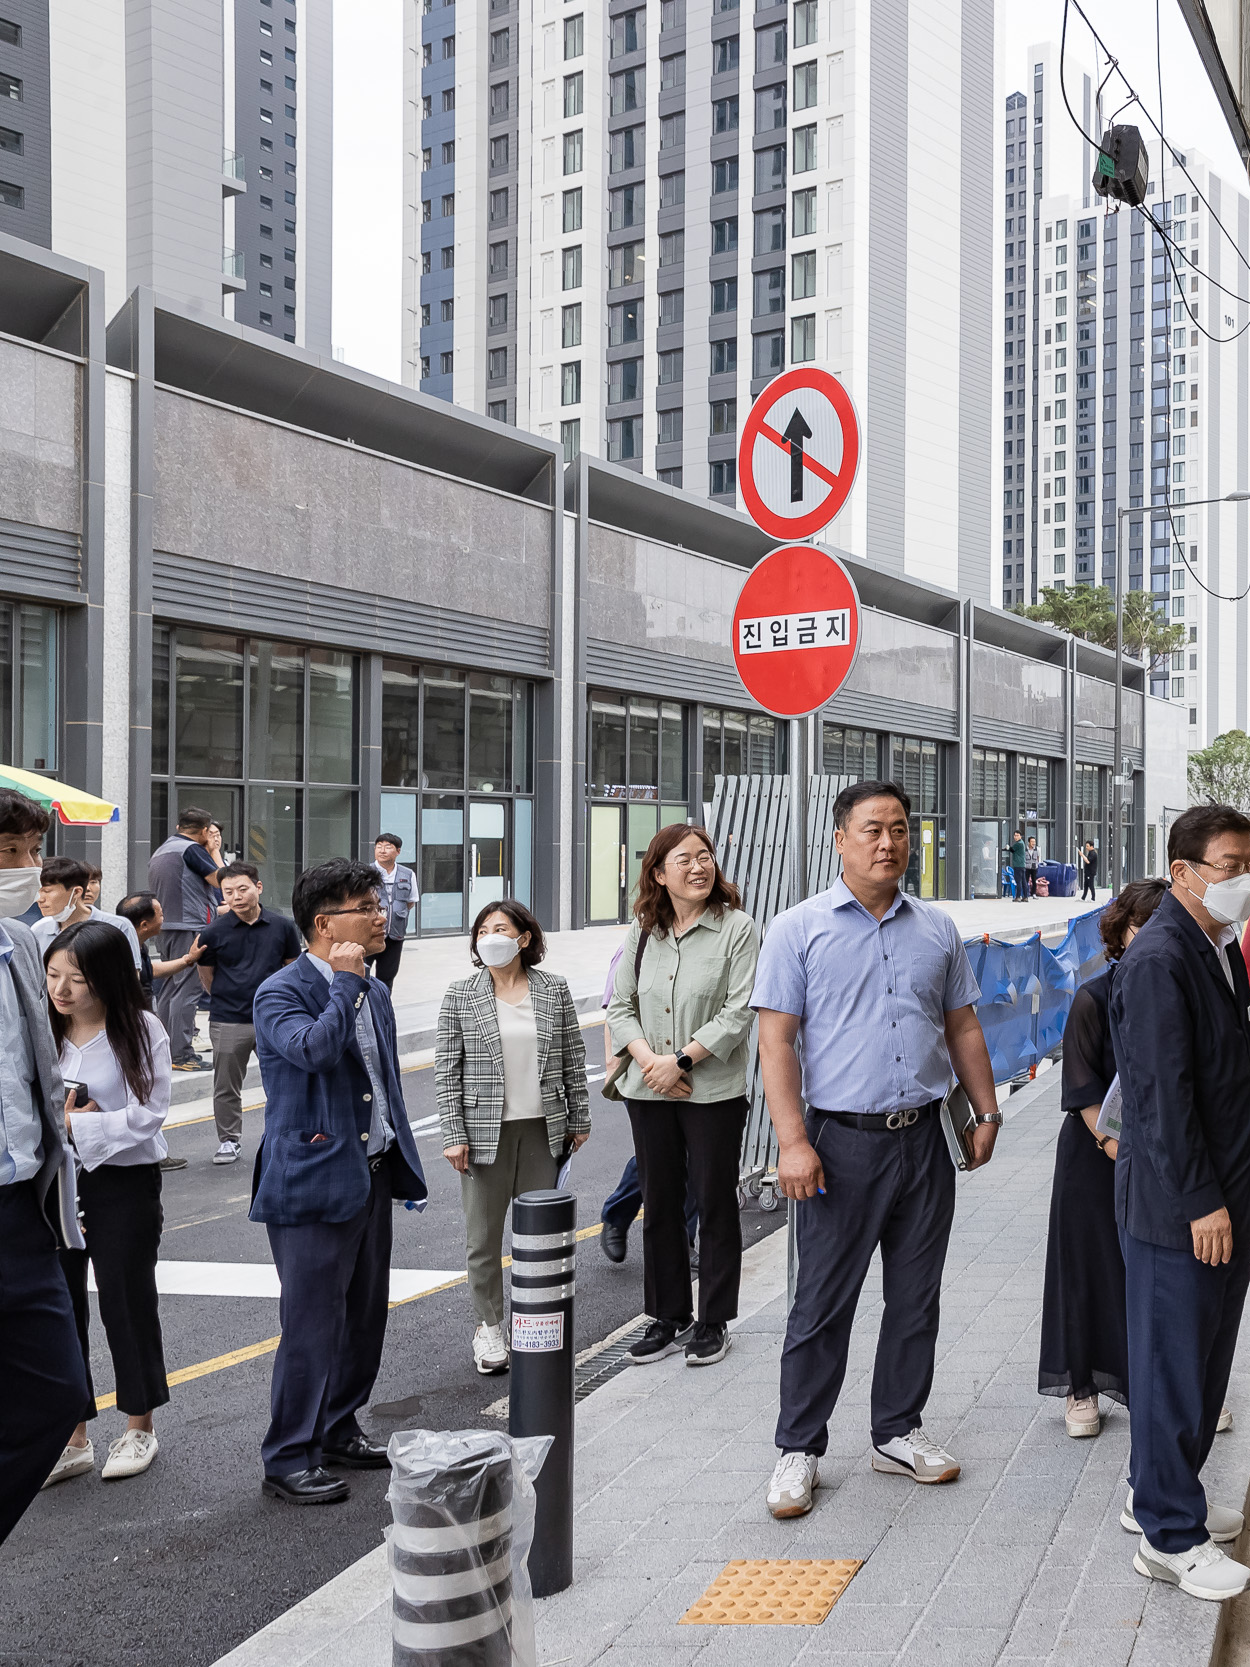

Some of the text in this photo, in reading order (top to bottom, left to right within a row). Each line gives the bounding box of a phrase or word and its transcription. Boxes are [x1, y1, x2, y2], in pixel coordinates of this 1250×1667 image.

[1225, 315, 1235, 328] 101
[743, 612, 846, 649] 진입금지
[515, 1317, 532, 1328] 카드
[513, 1339, 560, 1349] 010-4183-3933
